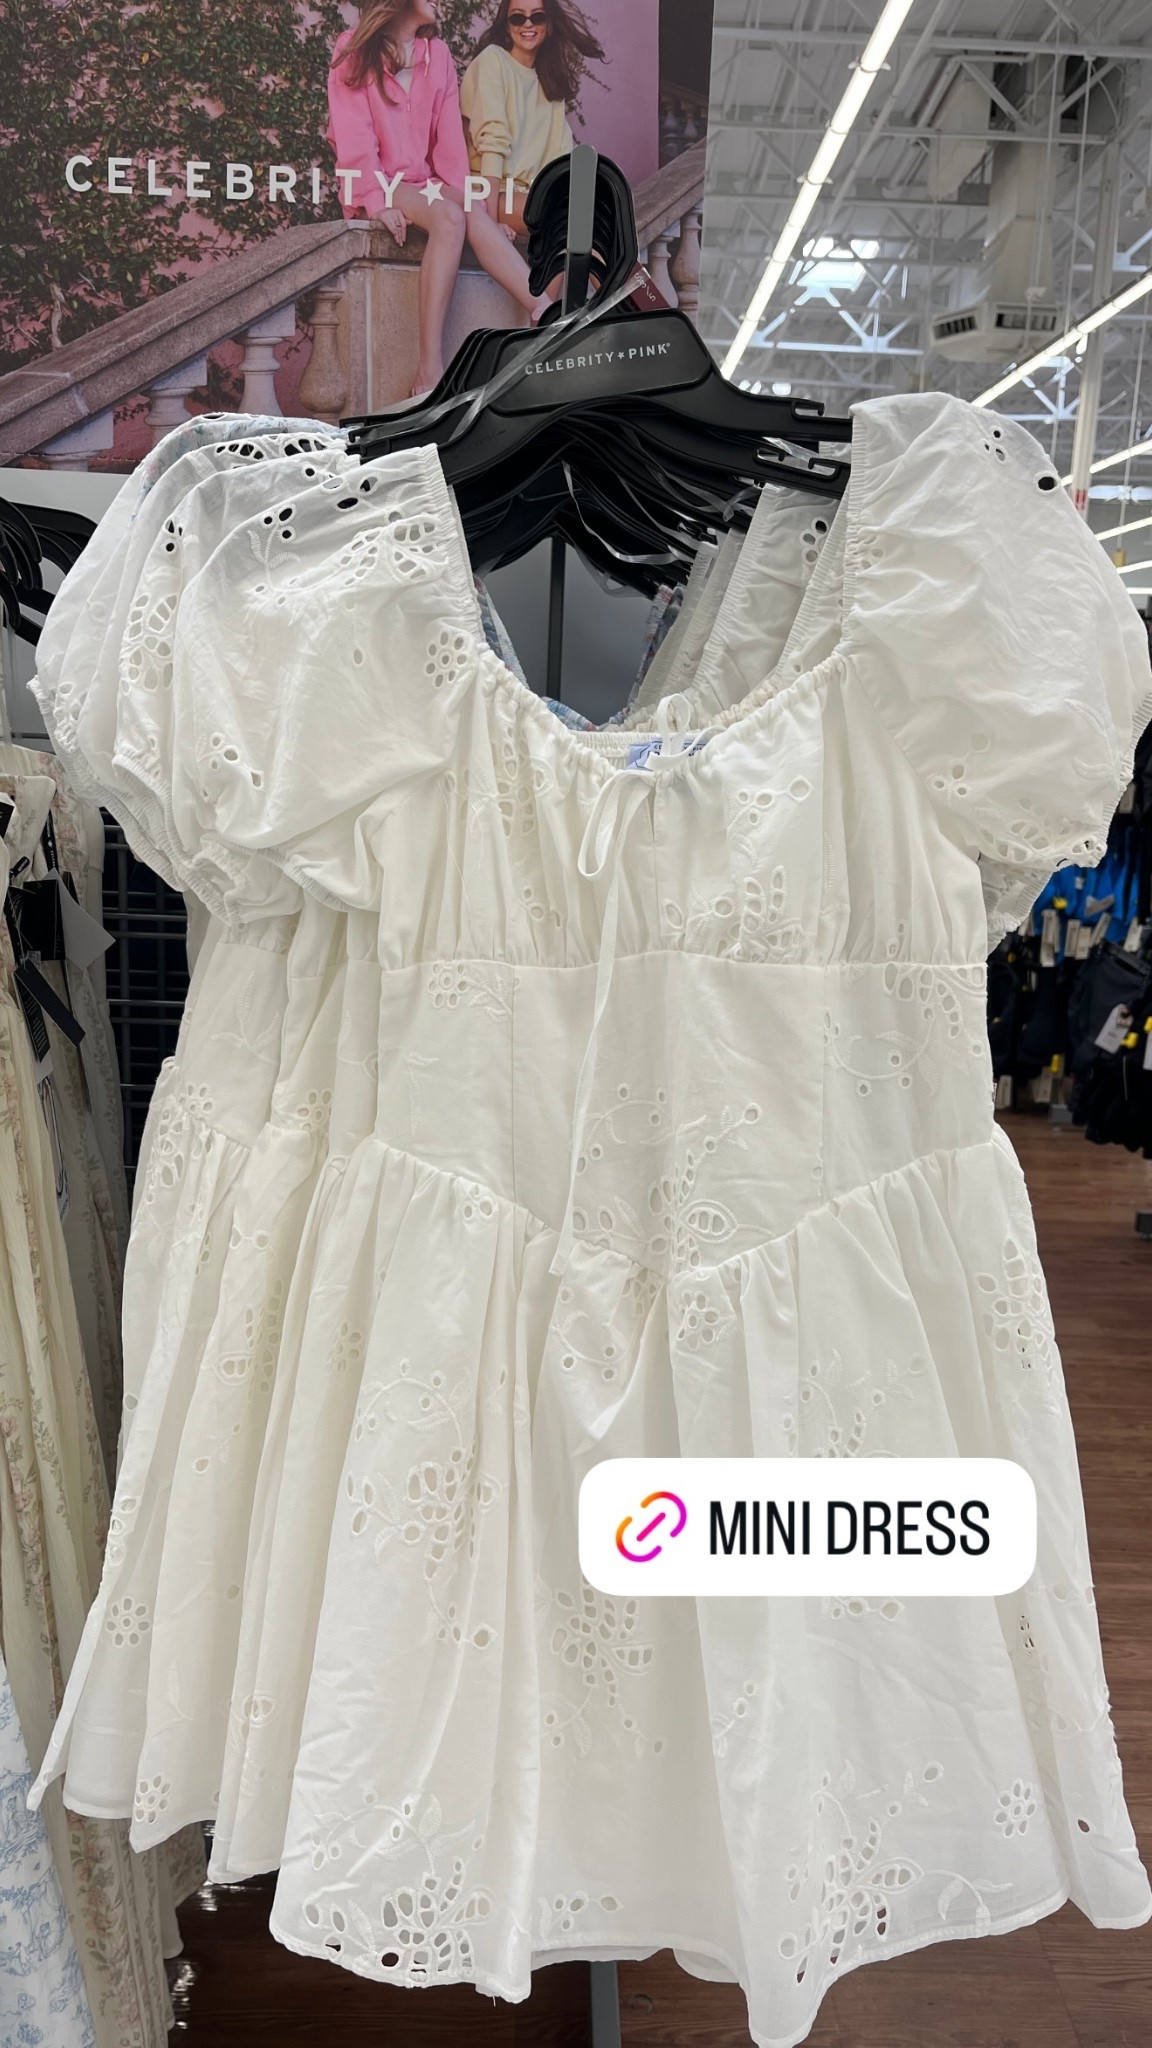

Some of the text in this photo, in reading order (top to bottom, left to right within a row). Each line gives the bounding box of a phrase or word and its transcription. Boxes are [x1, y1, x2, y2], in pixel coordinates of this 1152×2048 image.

[65, 155, 514, 214] CELEBRITY PI
[525, 351, 614, 375] CELEBRITY
